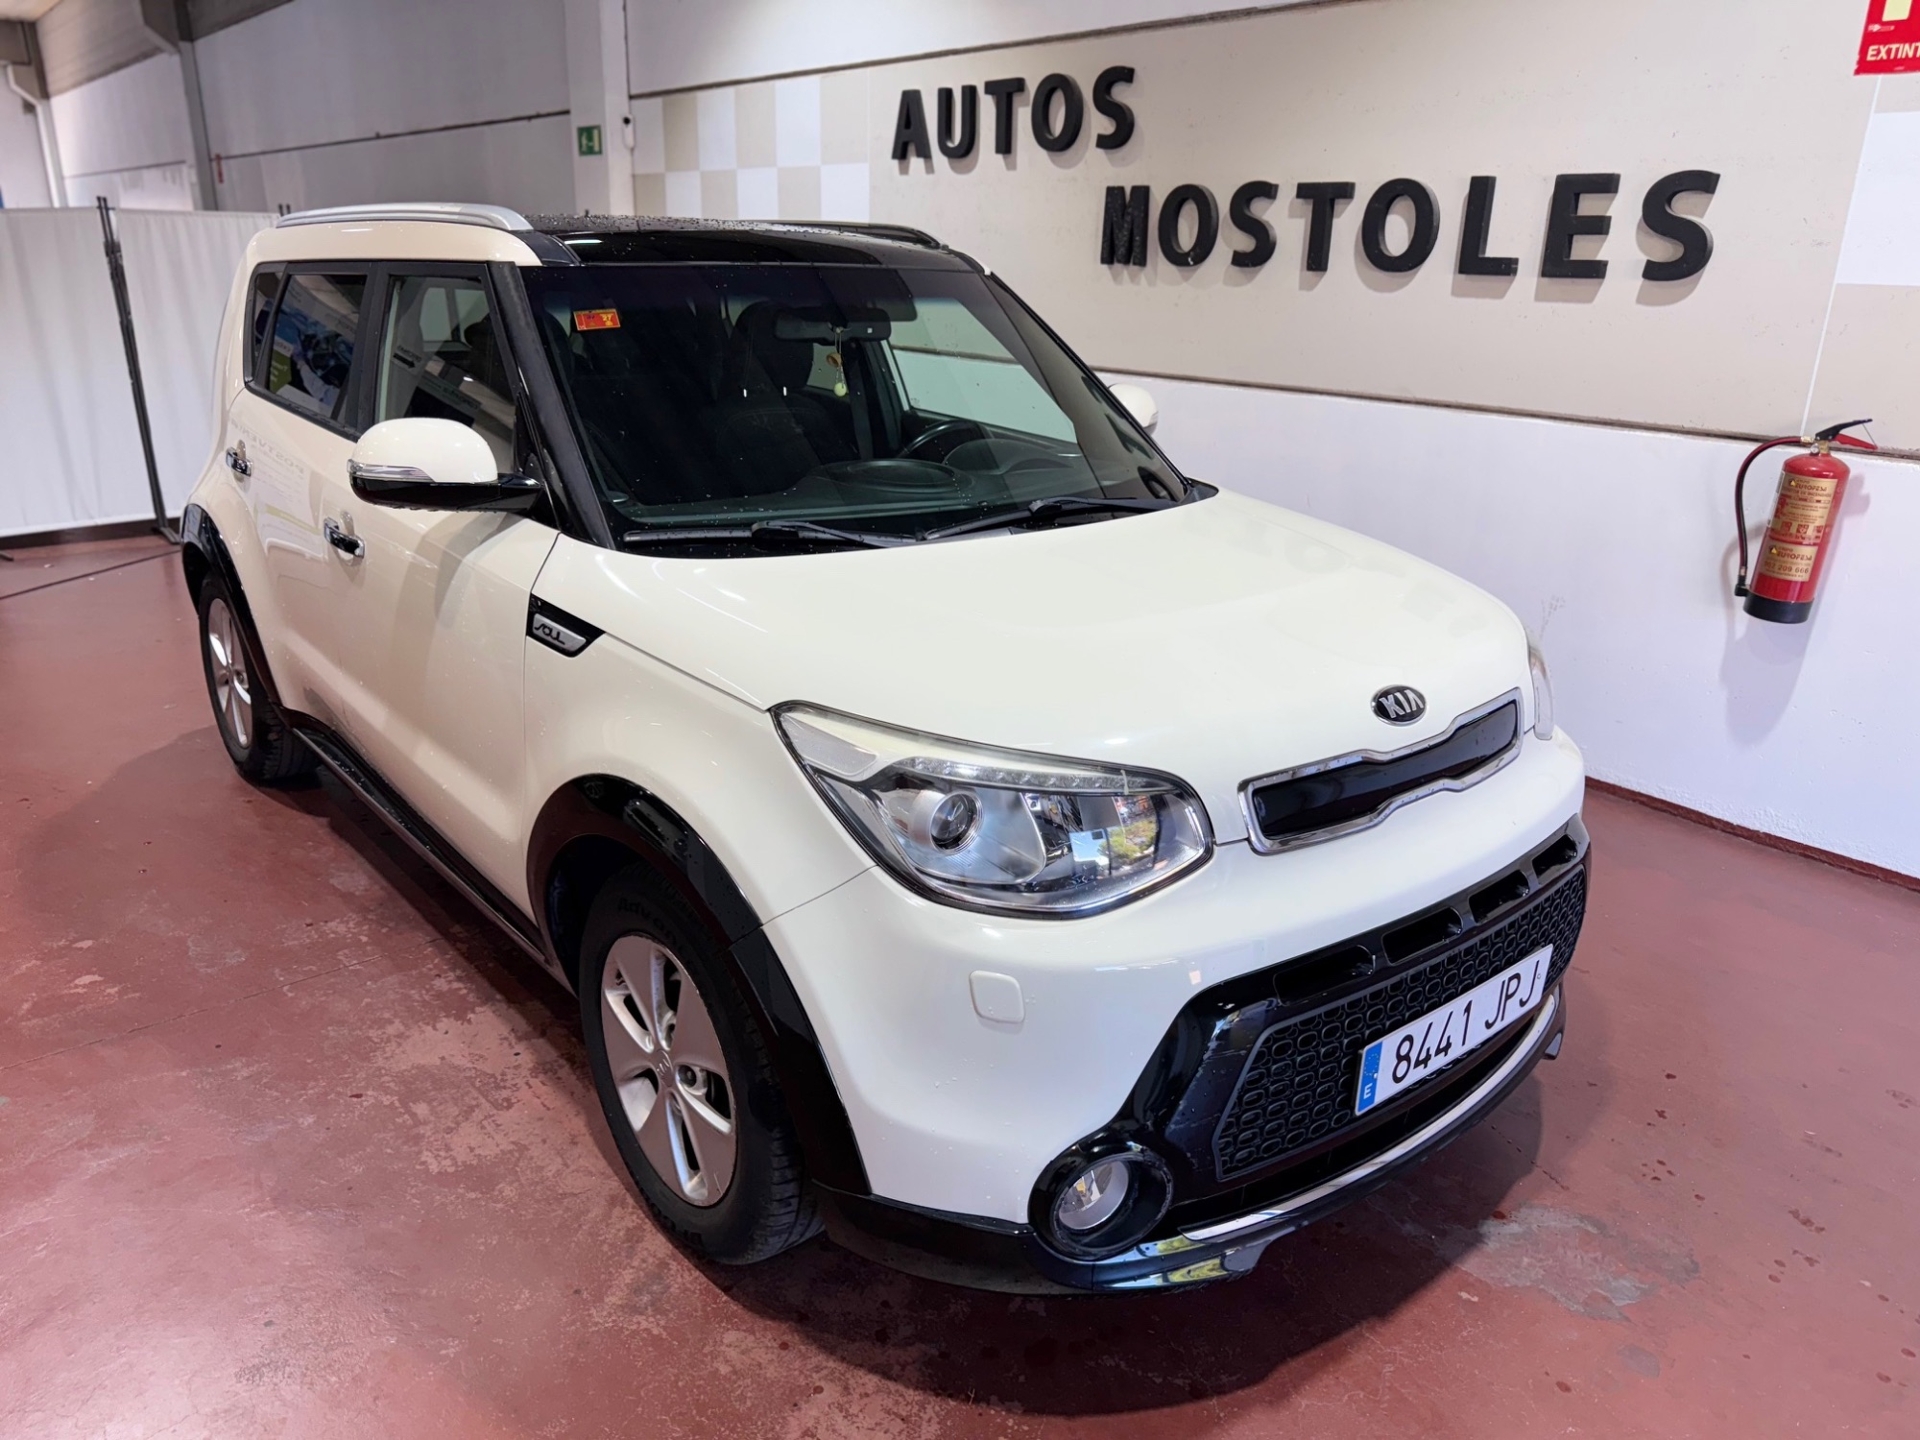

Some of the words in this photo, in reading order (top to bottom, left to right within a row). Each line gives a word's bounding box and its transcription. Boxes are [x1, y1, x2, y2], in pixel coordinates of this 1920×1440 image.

[891, 66, 1135, 160] AUTOS
[1100, 169, 1721, 281] MOSTOLES
[1379, 689, 1424, 718] KIA
[1392, 1000, 1472, 1084] 8441
[1485, 960, 1540, 1029] JPJ
[1363, 1083, 1373, 1099] E
